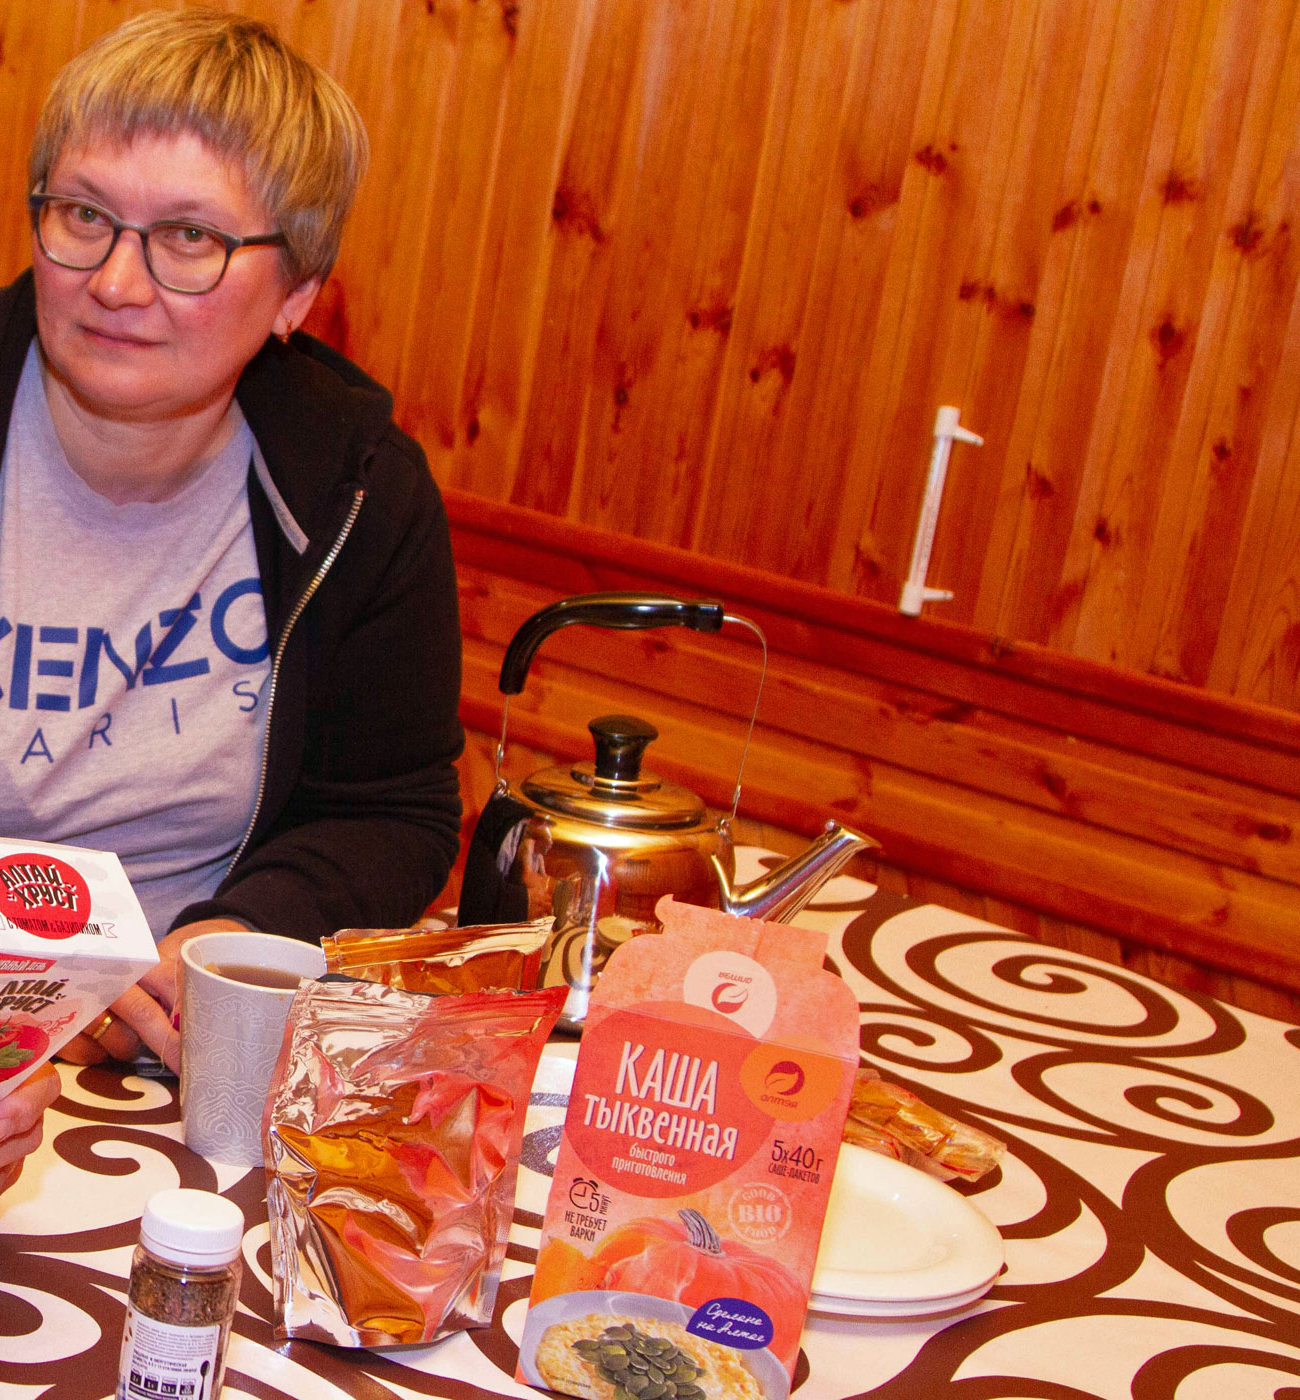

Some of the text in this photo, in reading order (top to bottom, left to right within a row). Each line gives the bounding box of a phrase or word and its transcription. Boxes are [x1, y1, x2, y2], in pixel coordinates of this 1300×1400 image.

[14, 885, 79, 912] ХРУСТ
[27, 962, 46, 971] ДЕНЬ
[615, 1041, 719, 1115] КАША
[629, 1142, 676, 1167] быстрого
[612, 1156, 687, 1185] приготовления
[768, 1164, 821, 1185] САШЕ-ПАКЕТОВ
[589, 1192, 601, 1212] 5
[564, 1210, 608, 1231] НЕ ТРЕБУЕТ
[738, 1204, 783, 1225] BIO
[570, 1225, 596, 1242] ВАРКИ
